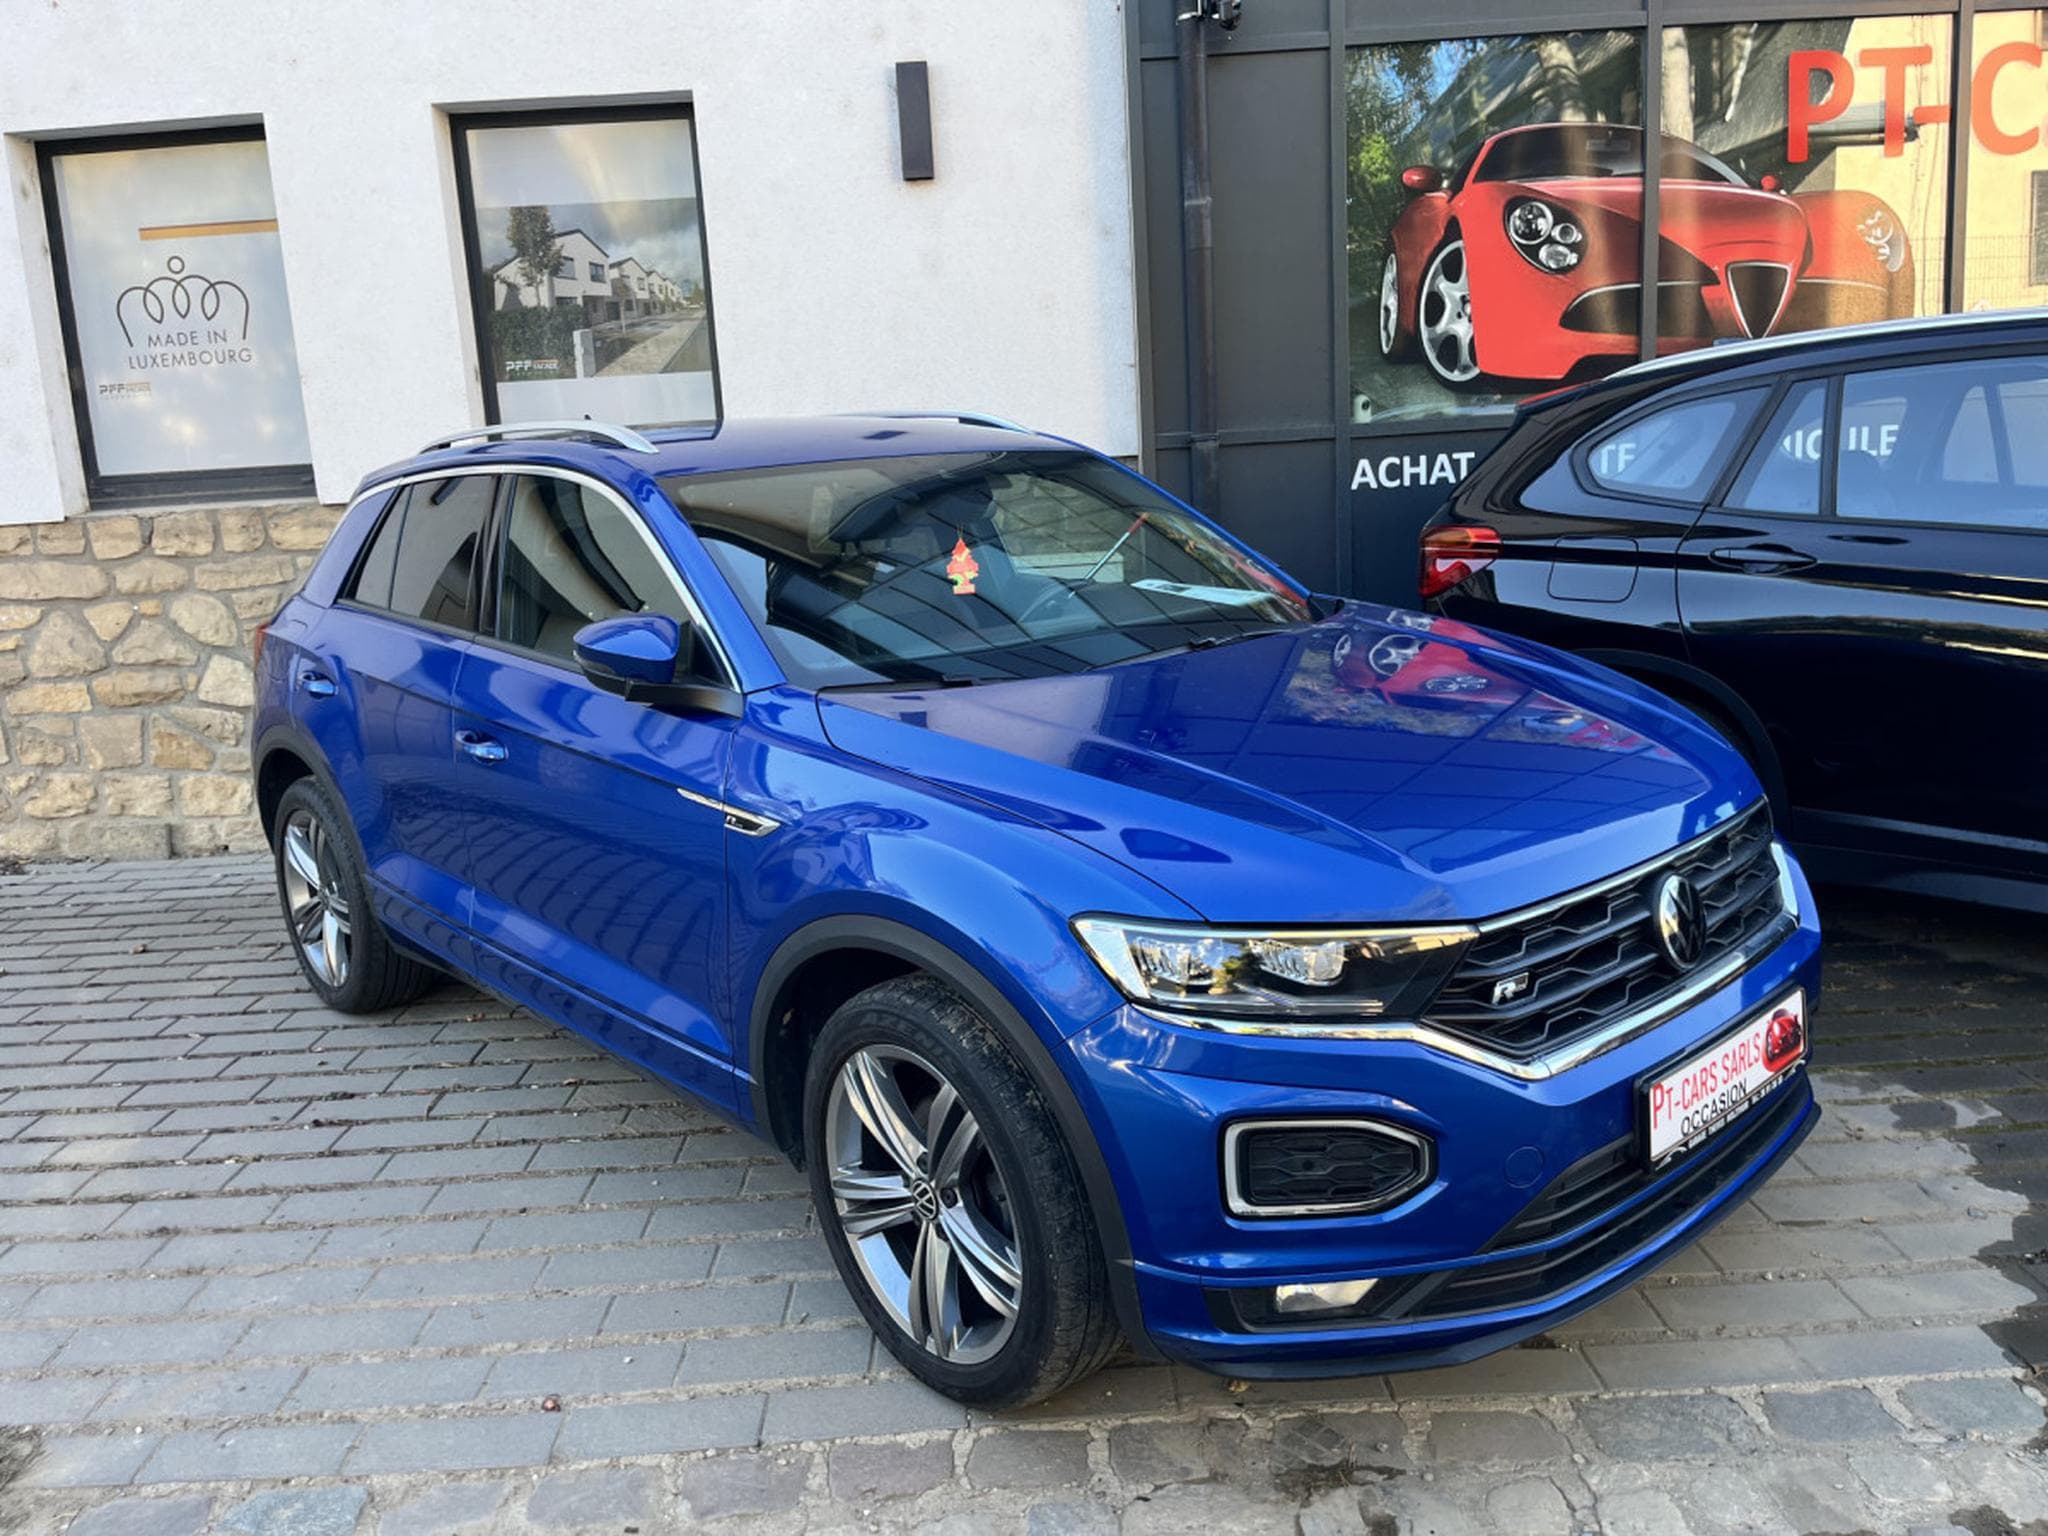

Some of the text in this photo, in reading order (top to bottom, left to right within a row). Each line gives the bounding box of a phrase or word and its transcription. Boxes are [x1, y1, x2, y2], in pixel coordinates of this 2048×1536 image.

[1787, 41, 2048, 163] PT-C
[128, 348, 252, 369] LUXEMBOURG
[148, 329, 227, 347] MADE IN
[1351, 452, 1476, 490] ACHAT
[1722, 1032, 1761, 1085] SARLS
[1681, 1077, 1747, 1138] OCCASION
